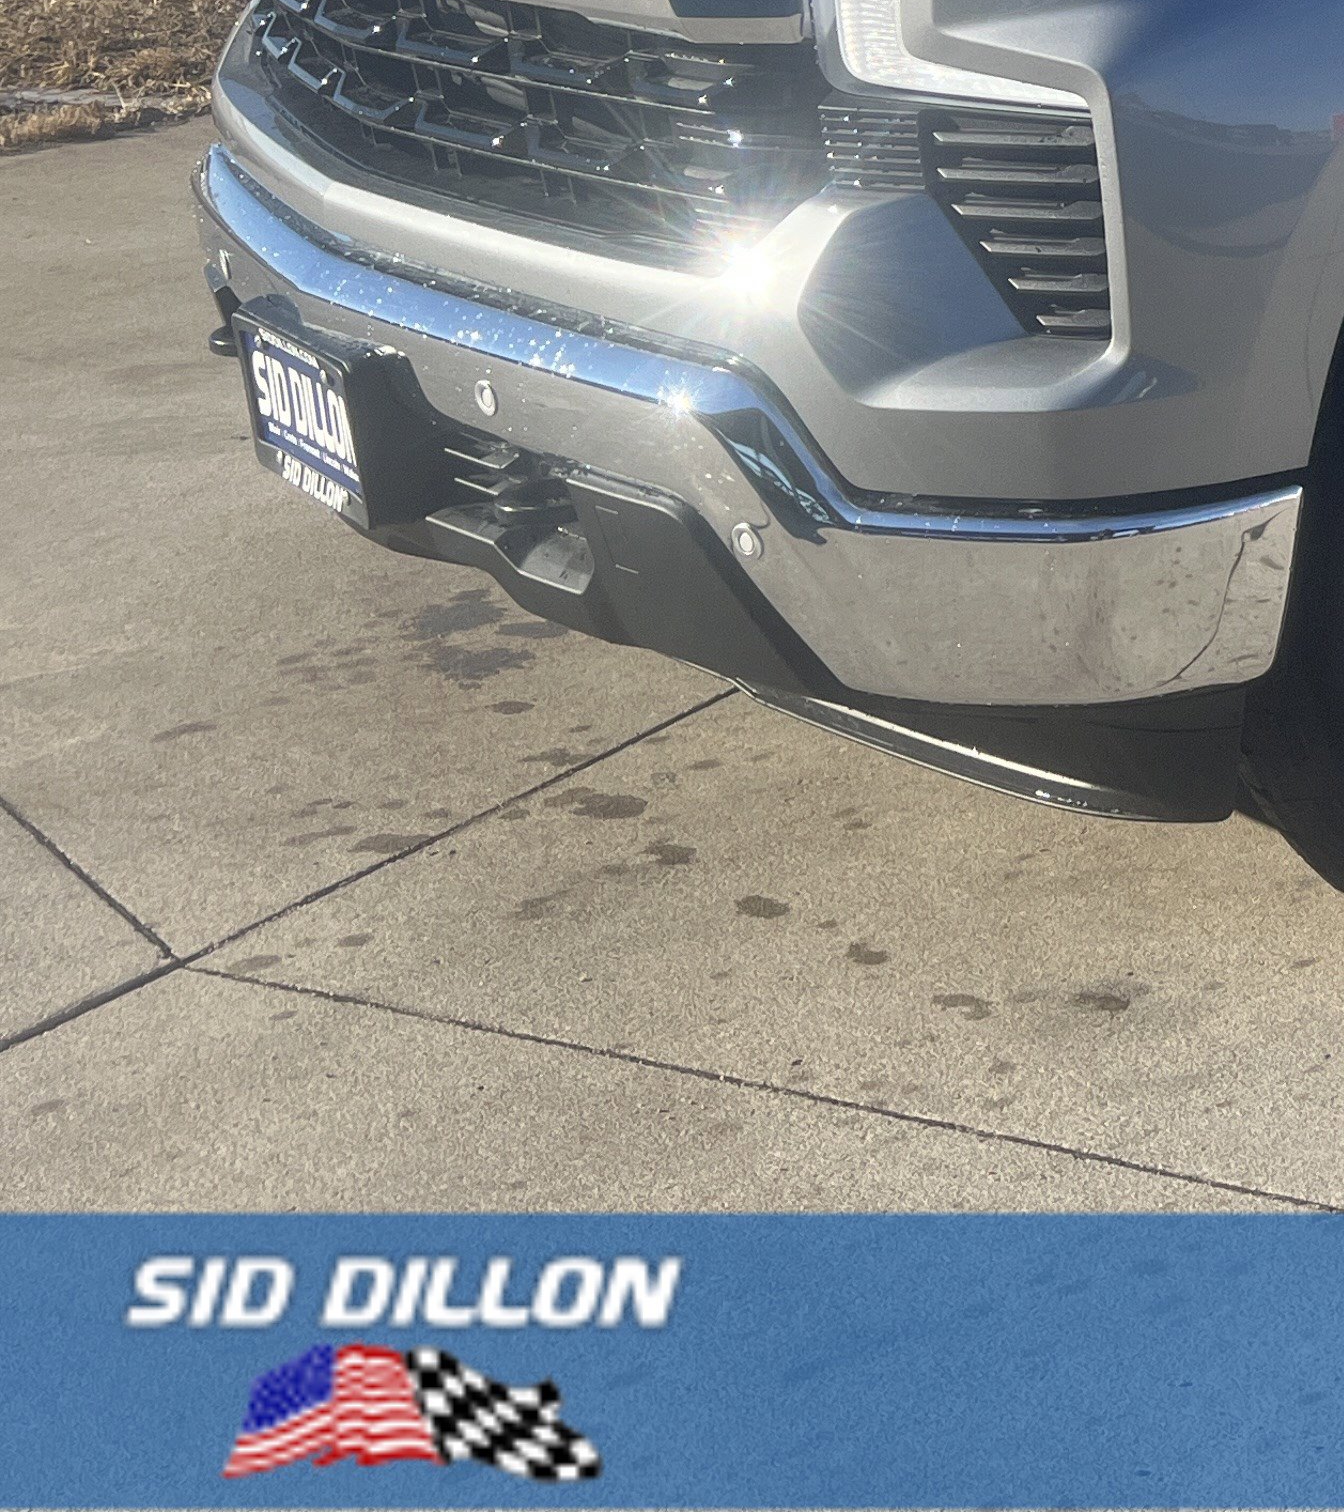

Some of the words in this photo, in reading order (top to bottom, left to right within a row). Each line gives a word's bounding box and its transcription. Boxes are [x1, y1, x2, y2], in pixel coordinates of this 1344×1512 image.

[252, 350, 292, 427] SID
[288, 366, 357, 468] DILLON
[282, 454, 302, 487] SID
[302, 466, 344, 513] DILLON
